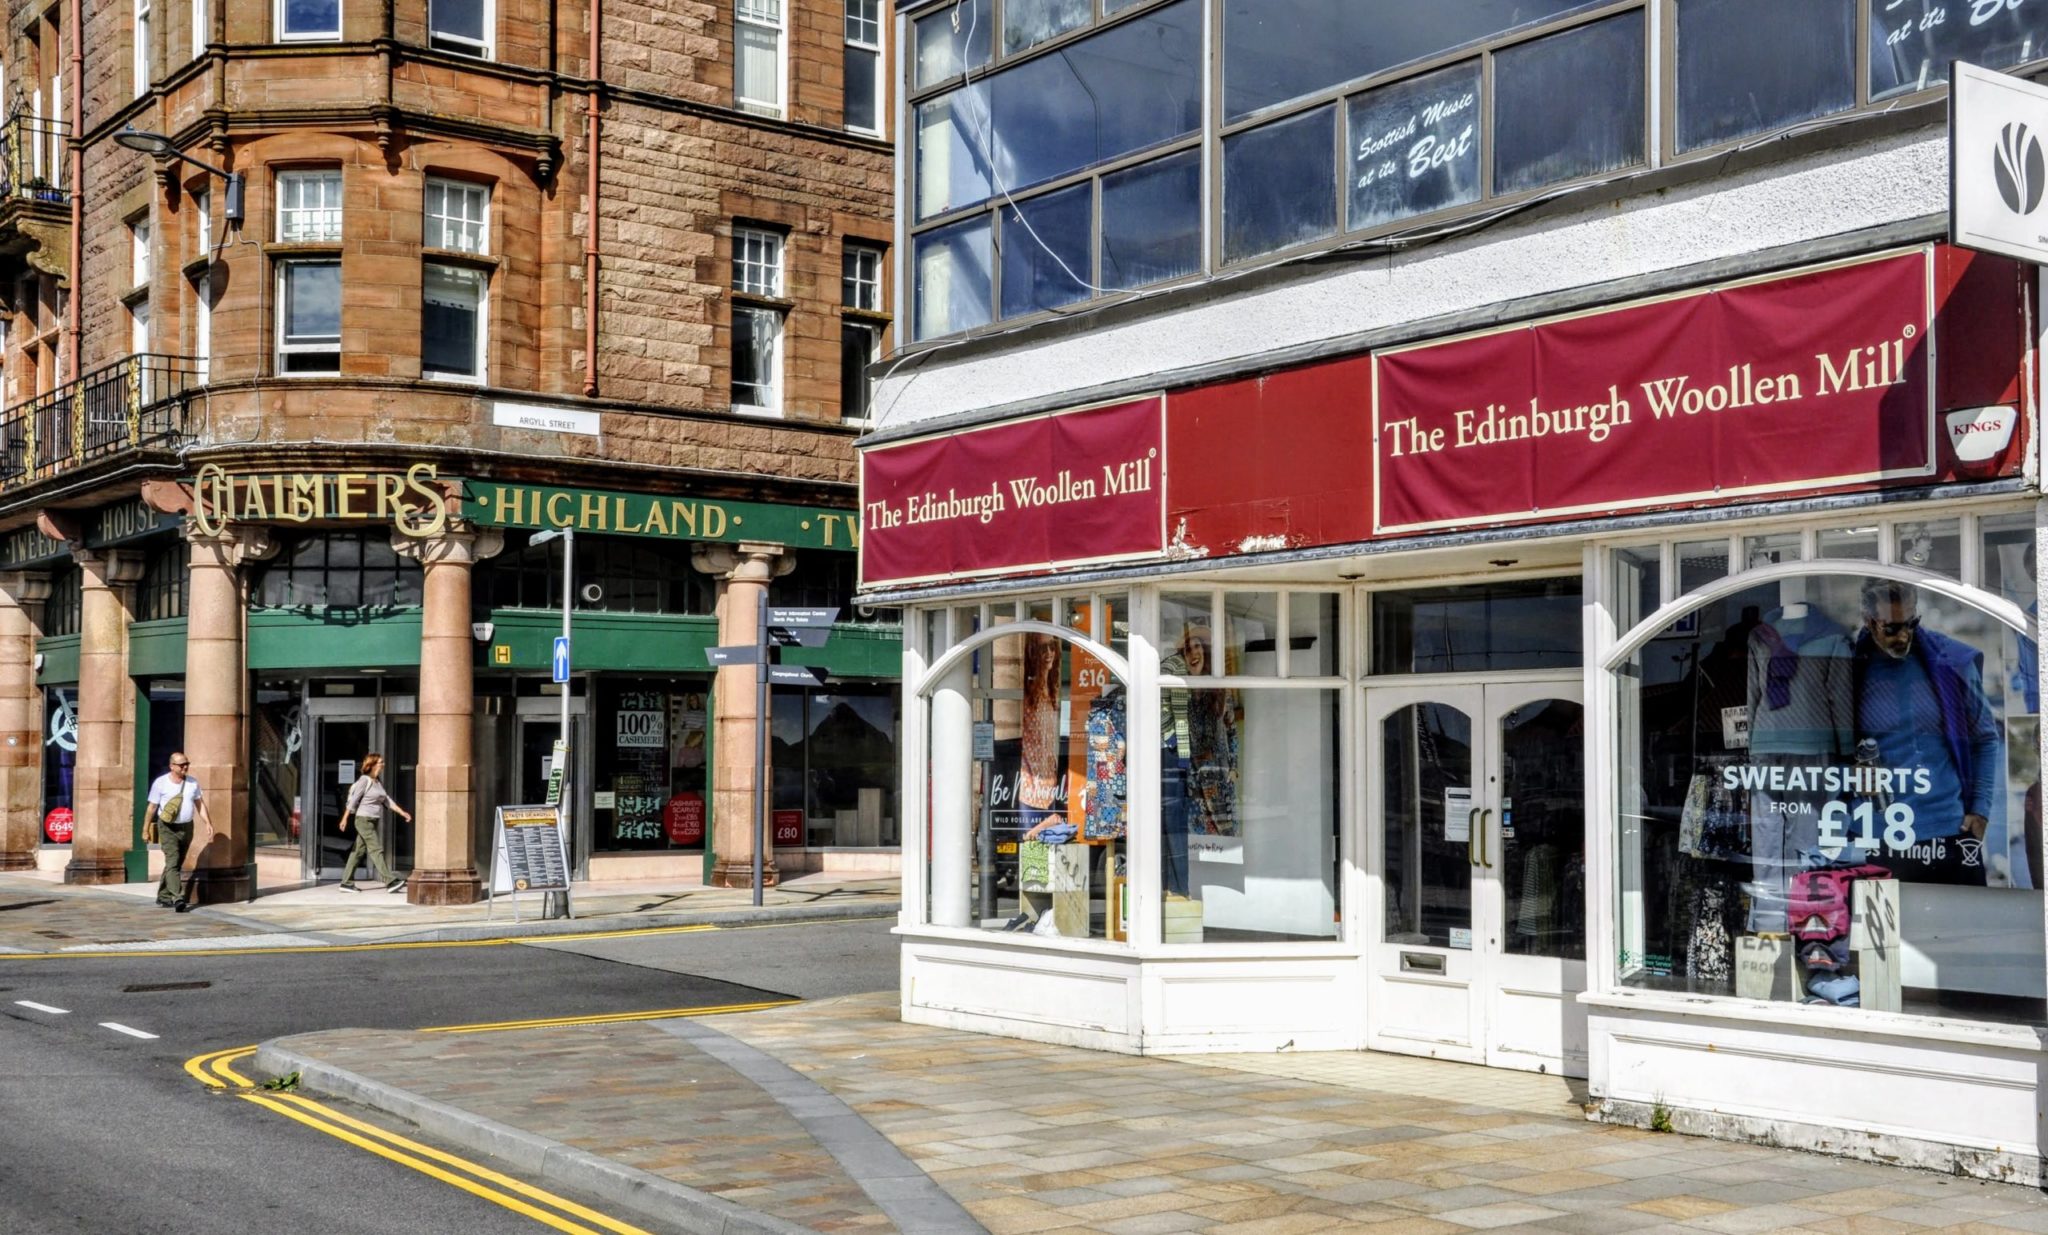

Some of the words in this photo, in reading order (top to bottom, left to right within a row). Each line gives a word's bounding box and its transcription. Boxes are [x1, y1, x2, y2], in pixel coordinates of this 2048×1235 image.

[1886, 19, 1913, 46] at
[1919, 6, 1946, 32] its
[1357, 115, 1416, 161] Scottish
[1422, 93, 1473, 128] Music
[1358, 169, 1375, 188] at
[1378, 160, 1397, 179] its
[1407, 124, 1473, 179] Best
[519, 416, 547, 428] ARGYLL
[549, 419, 576, 430] STREET
[1385, 415, 1445, 457] The
[1454, 384, 1632, 443] Edinburgh
[1640, 363, 1802, 420] Woollen
[1953, 419, 2002, 435] KINGS
[194, 462, 447, 538] CHALMERS
[494, 486, 728, 539] HIGHLAND
[867, 500, 902, 530] The
[907, 481, 1004, 524] Edinburgh
[1009, 470, 1096, 509] Woollen
[102, 502, 159, 542] HOUSE
[1079, 669, 1106, 688] £16
[618, 714, 663, 735] 100%
[618, 735, 663, 745] CASHMERE
[990, 774, 1011, 807] Be
[1723, 765, 1932, 795] SWEATSHIRTS
[777, 827, 798, 839] £80
[1770, 801, 1812, 814] FROM
[1817, 800, 1916, 851] £18
